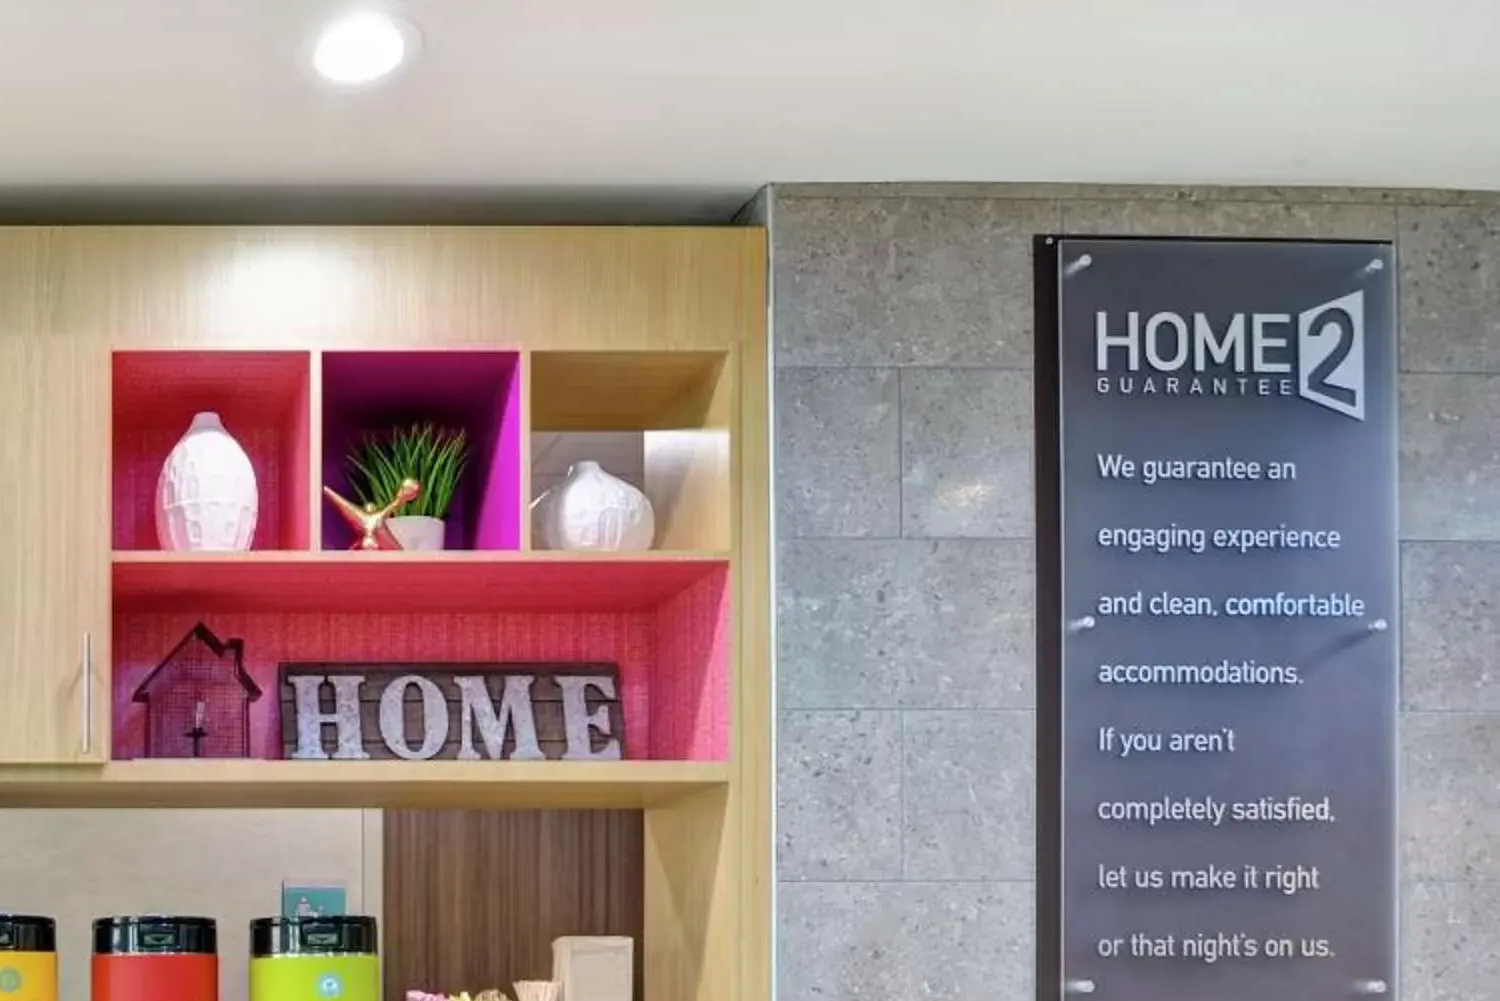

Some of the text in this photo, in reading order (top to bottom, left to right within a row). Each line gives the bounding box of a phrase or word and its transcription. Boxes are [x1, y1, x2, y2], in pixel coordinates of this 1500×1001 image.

[1097, 376, 1293, 395] GUARANTEE
[1098, 452, 1297, 485] We guarantee an
[1098, 522, 1341, 553] engaging experience
[1098, 590, 1143, 615] and
[1225, 591, 1366, 617] comfortable
[1098, 659, 1304, 684] accommodations.
[286, 674, 621, 761] HOME
[1099, 726, 1236, 758] If you aren't
[1097, 795, 1227, 827] completely
[1099, 863, 1320, 895] let us make it right
[1098, 931, 1336, 963] or that night's on us.
